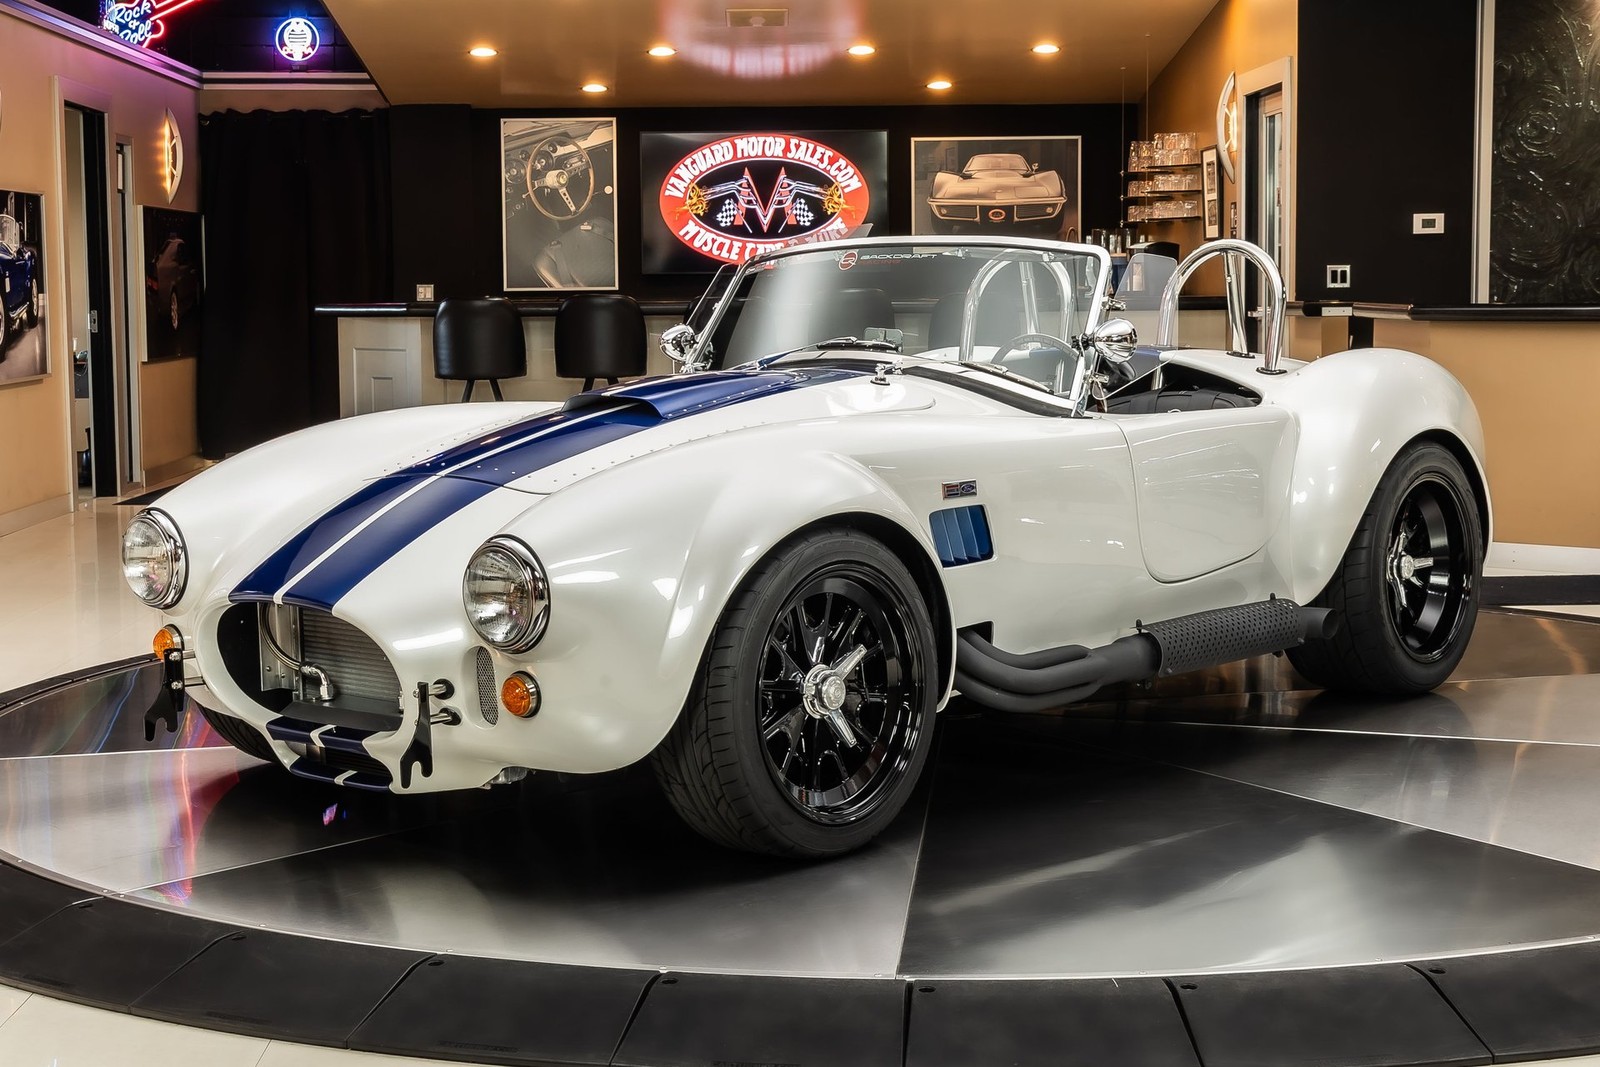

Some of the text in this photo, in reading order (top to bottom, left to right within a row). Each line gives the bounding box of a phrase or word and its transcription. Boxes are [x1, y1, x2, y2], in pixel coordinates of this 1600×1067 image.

[115, 0, 151, 24] Rock
[664, 136, 862, 199] VANGUARD MOTOR SALES.COM
[678, 219, 742, 261] MUSCLE
